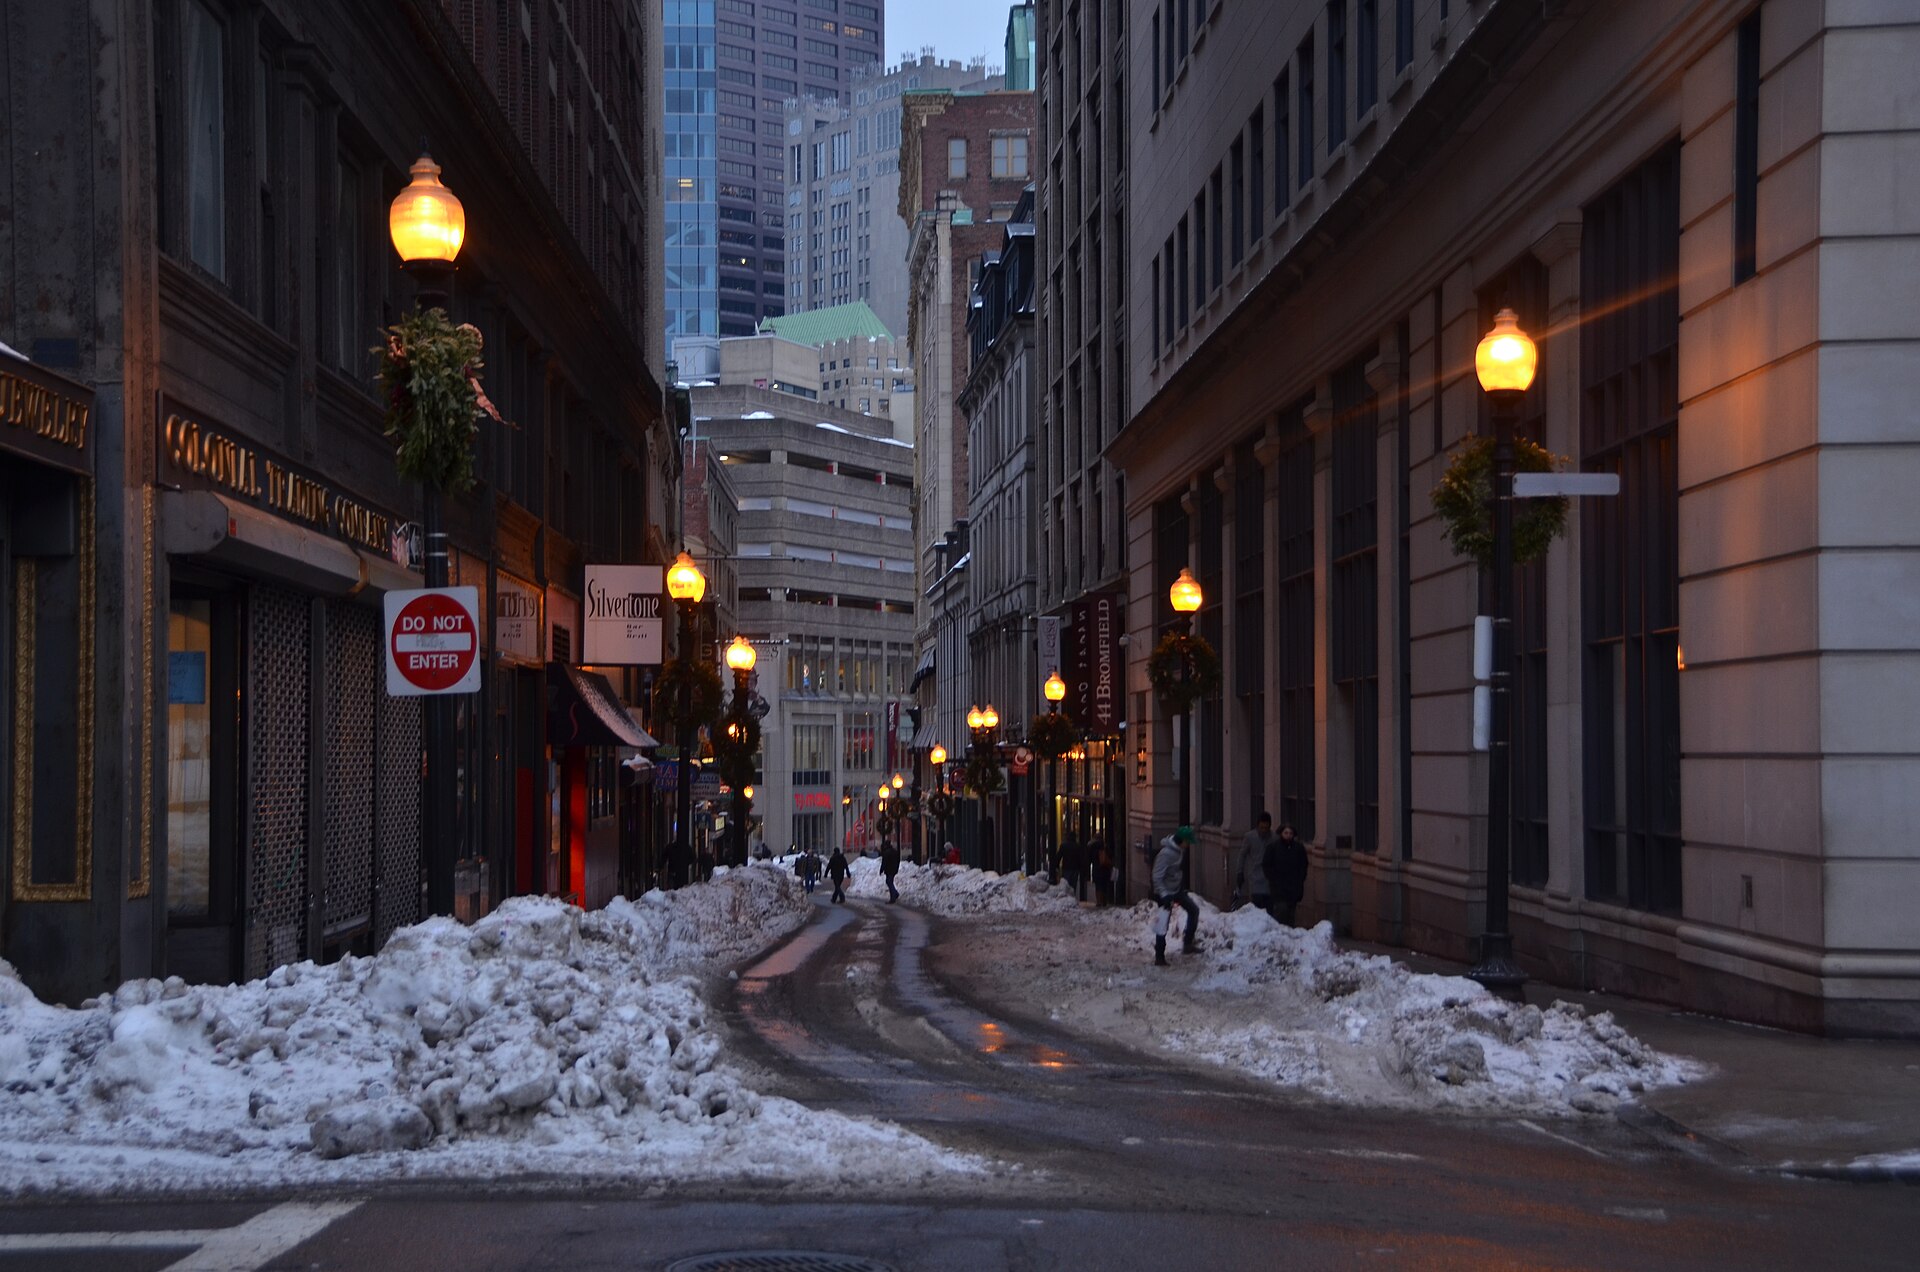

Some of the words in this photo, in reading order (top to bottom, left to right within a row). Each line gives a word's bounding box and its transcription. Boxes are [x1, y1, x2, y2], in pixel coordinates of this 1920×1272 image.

[165, 412, 262, 497] COLONIAL
[265, 459, 330, 528] TRADING
[587, 578, 660, 618] Silvertone
[402, 615, 426, 631] DO
[433, 614, 465, 630] NOT
[409, 653, 459, 669] ENTER
[1096, 599, 1112, 700] BROMFIELD
[1096, 702, 1111, 726] 44
